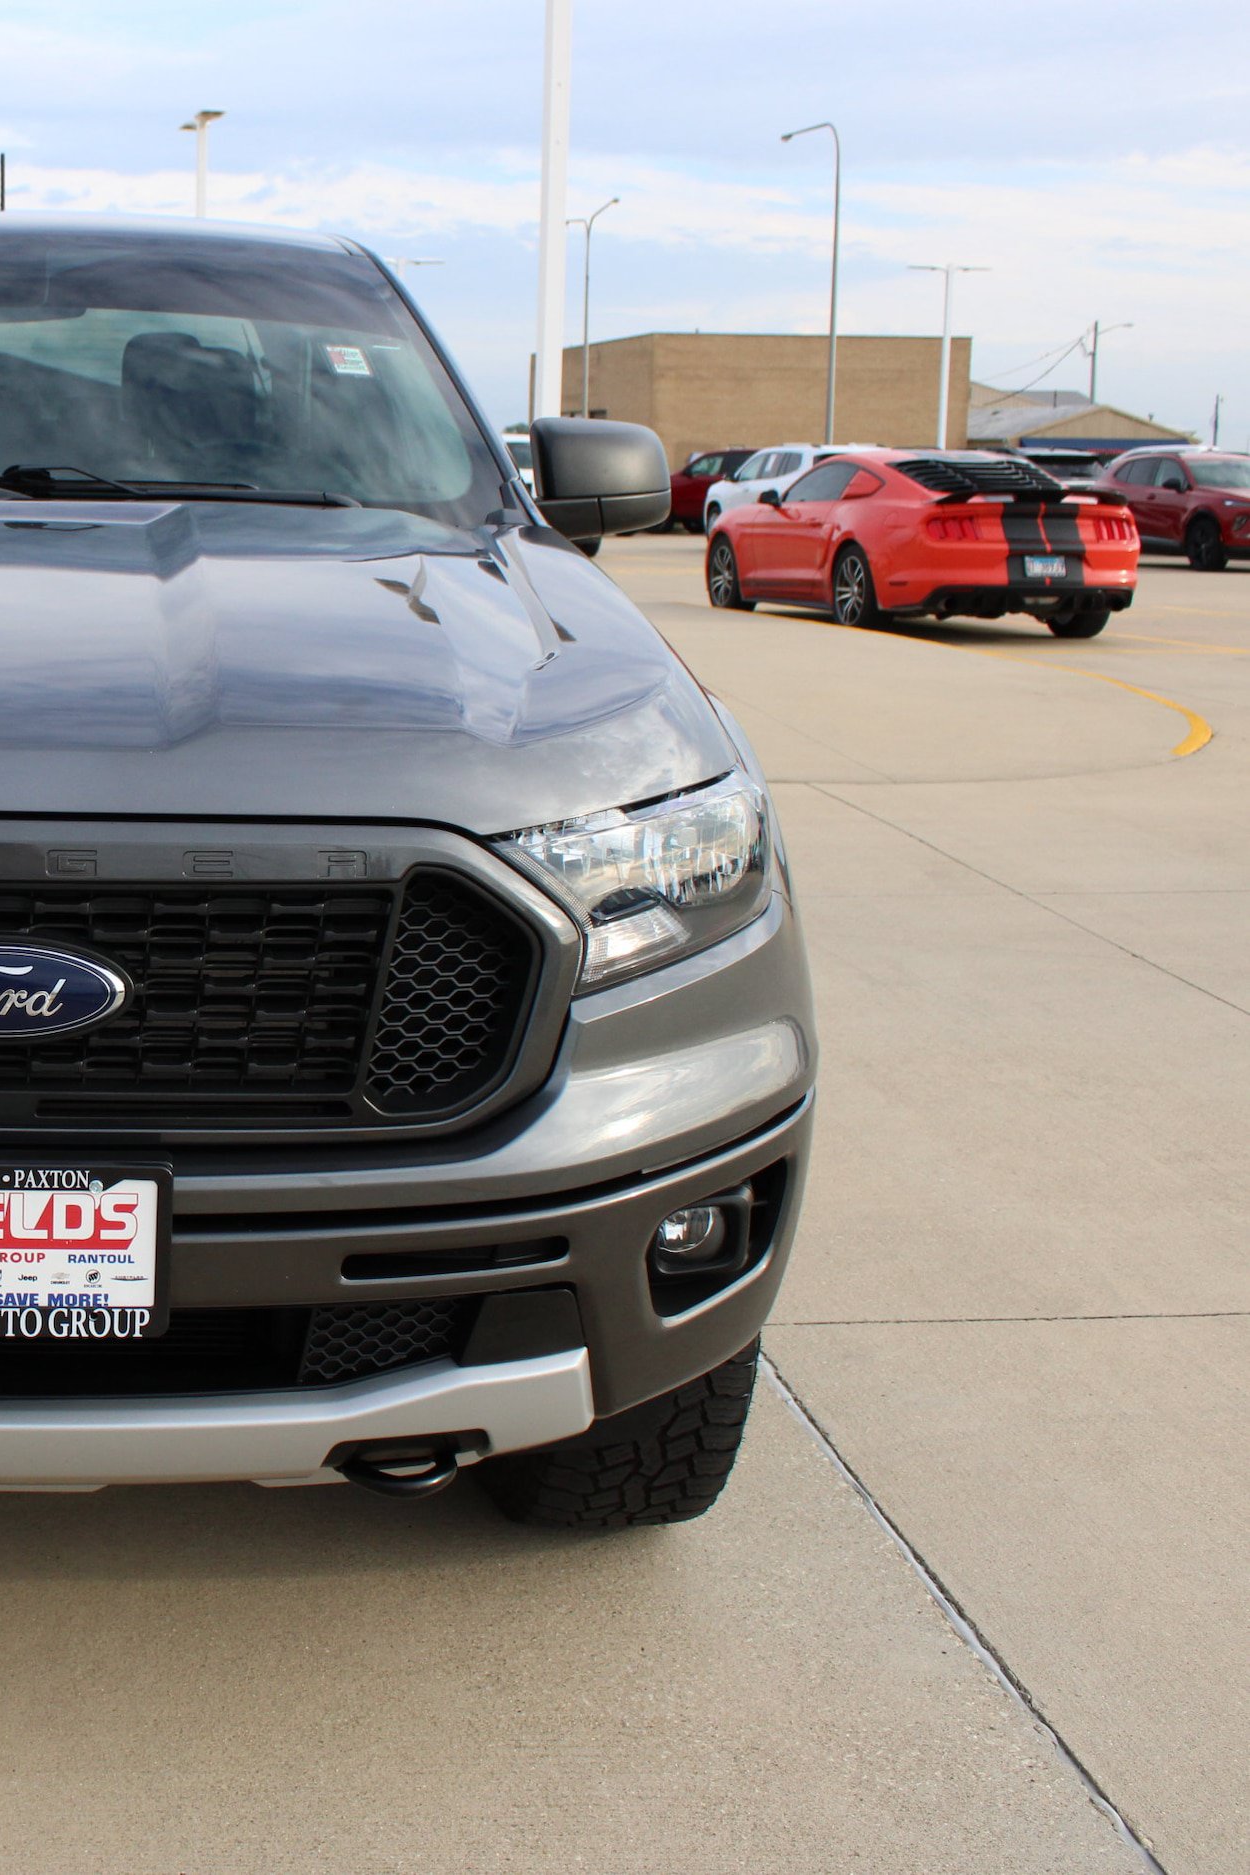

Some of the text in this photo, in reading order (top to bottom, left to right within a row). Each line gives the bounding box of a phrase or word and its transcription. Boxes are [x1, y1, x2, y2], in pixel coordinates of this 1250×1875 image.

[14, 1169, 91, 1189] PAXTON
[67, 1253, 135, 1264] RANTOUL
[17, 1274, 38, 1282] Jeep
[47, 1292, 109, 1308] MORE!
[48, 1307, 151, 1338] GROUP
